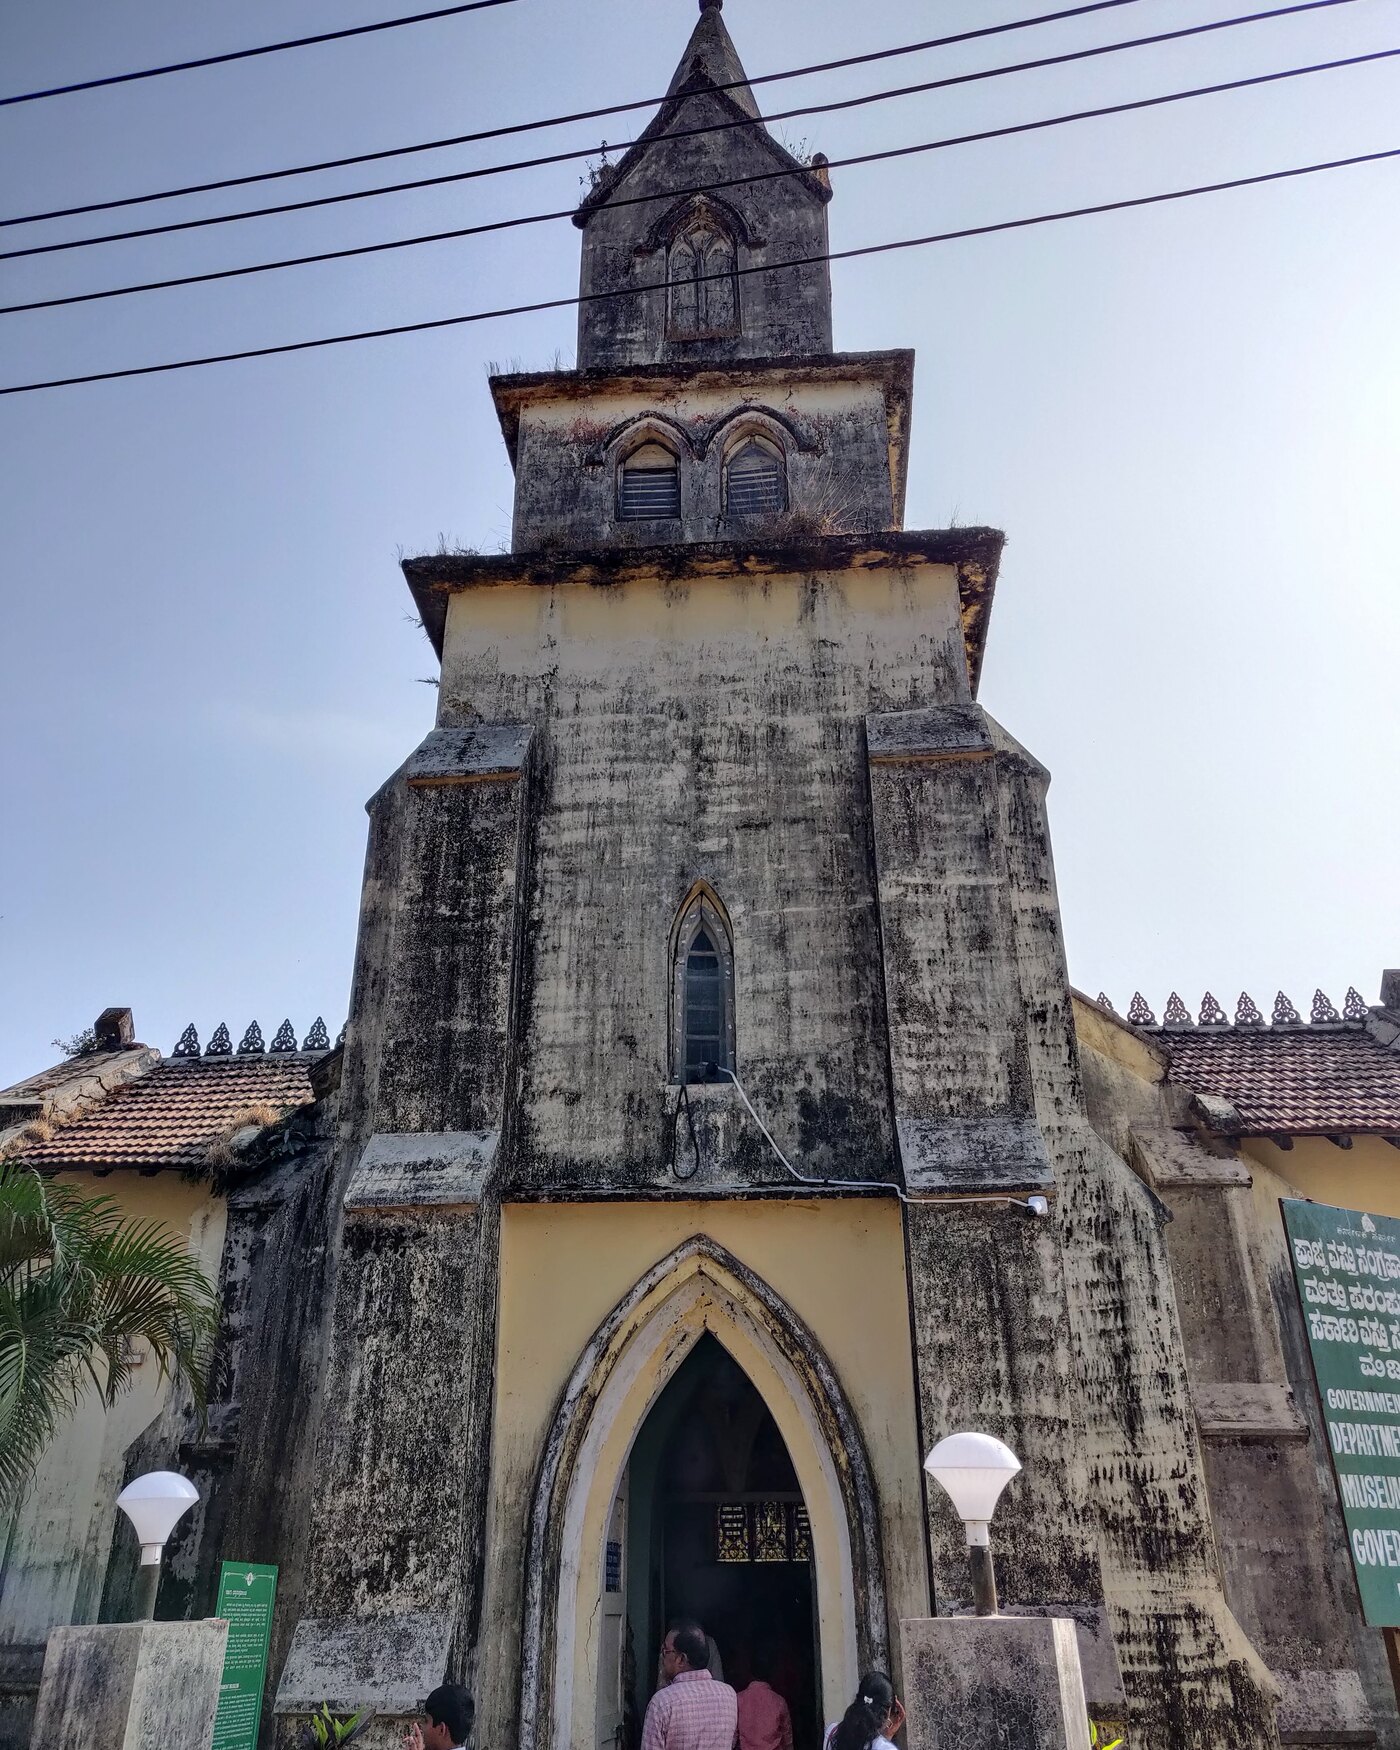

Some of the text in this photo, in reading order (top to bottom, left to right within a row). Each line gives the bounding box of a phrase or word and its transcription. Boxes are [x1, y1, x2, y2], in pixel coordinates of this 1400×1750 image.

[1326, 1239, 1359, 1276] ವಸ್ತು
[1304, 1275, 1400, 1316] ಮತ್ತು ಪರಂಪ
[1358, 1315, 1391, 1352] ವಸ್ತು
[1329, 1421, 1400, 1457] DEPARTME
